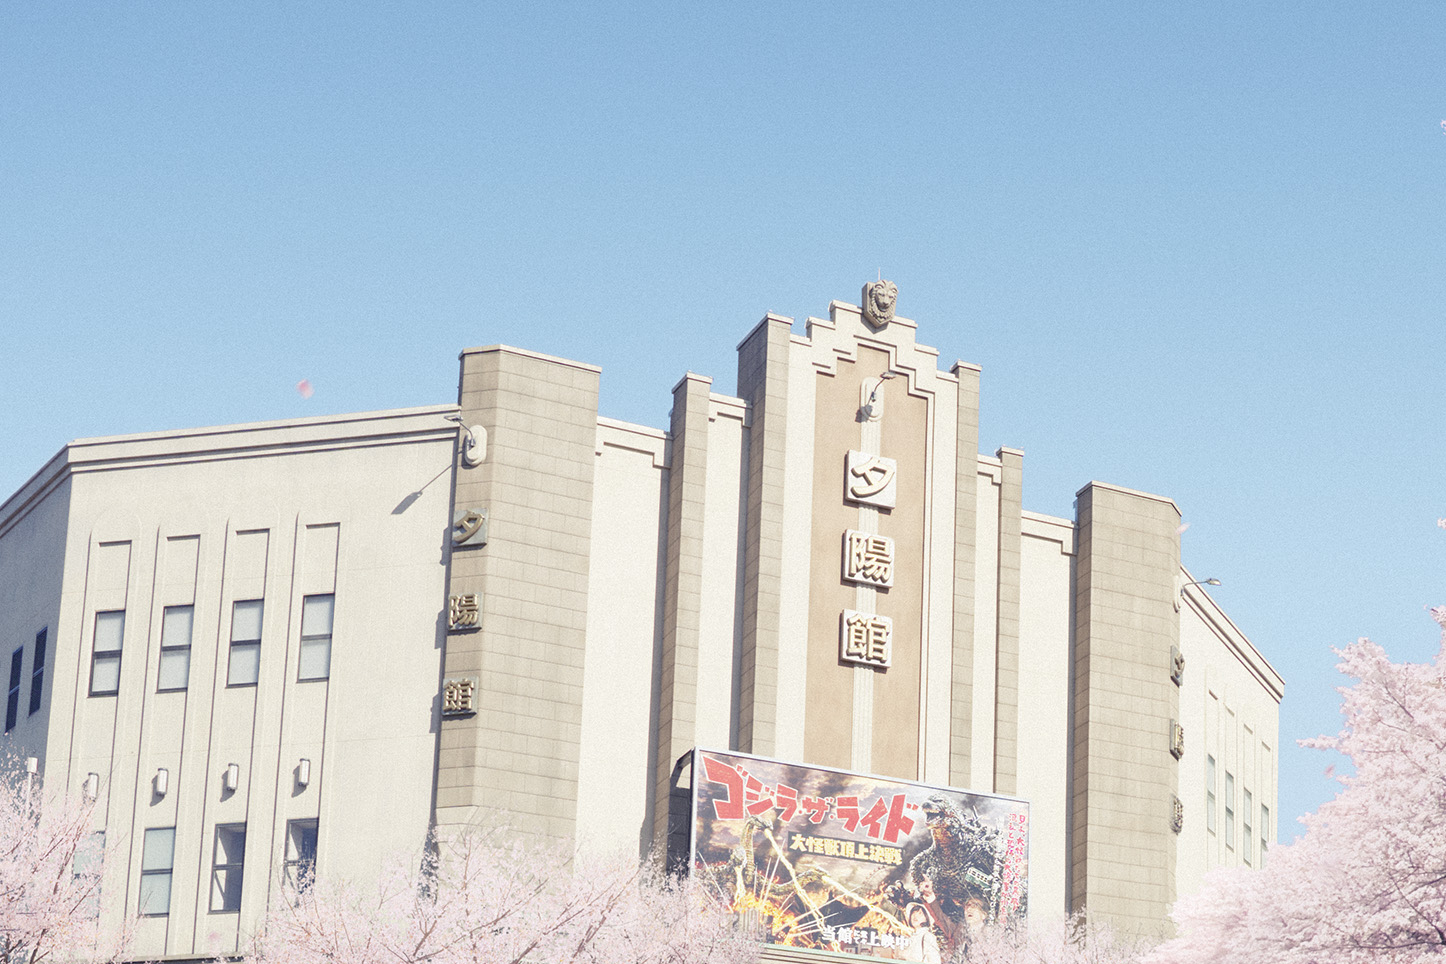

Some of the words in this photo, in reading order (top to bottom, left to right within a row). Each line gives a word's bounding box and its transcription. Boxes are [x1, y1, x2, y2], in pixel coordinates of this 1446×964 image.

[443, 509, 485, 713] 夕陽館
[846, 456, 895, 663] 夕陽館
[701, 755, 919, 844] ゴジラ・ザ・ライド
[789, 833, 903, 866] 大怪獣頂上決戦
